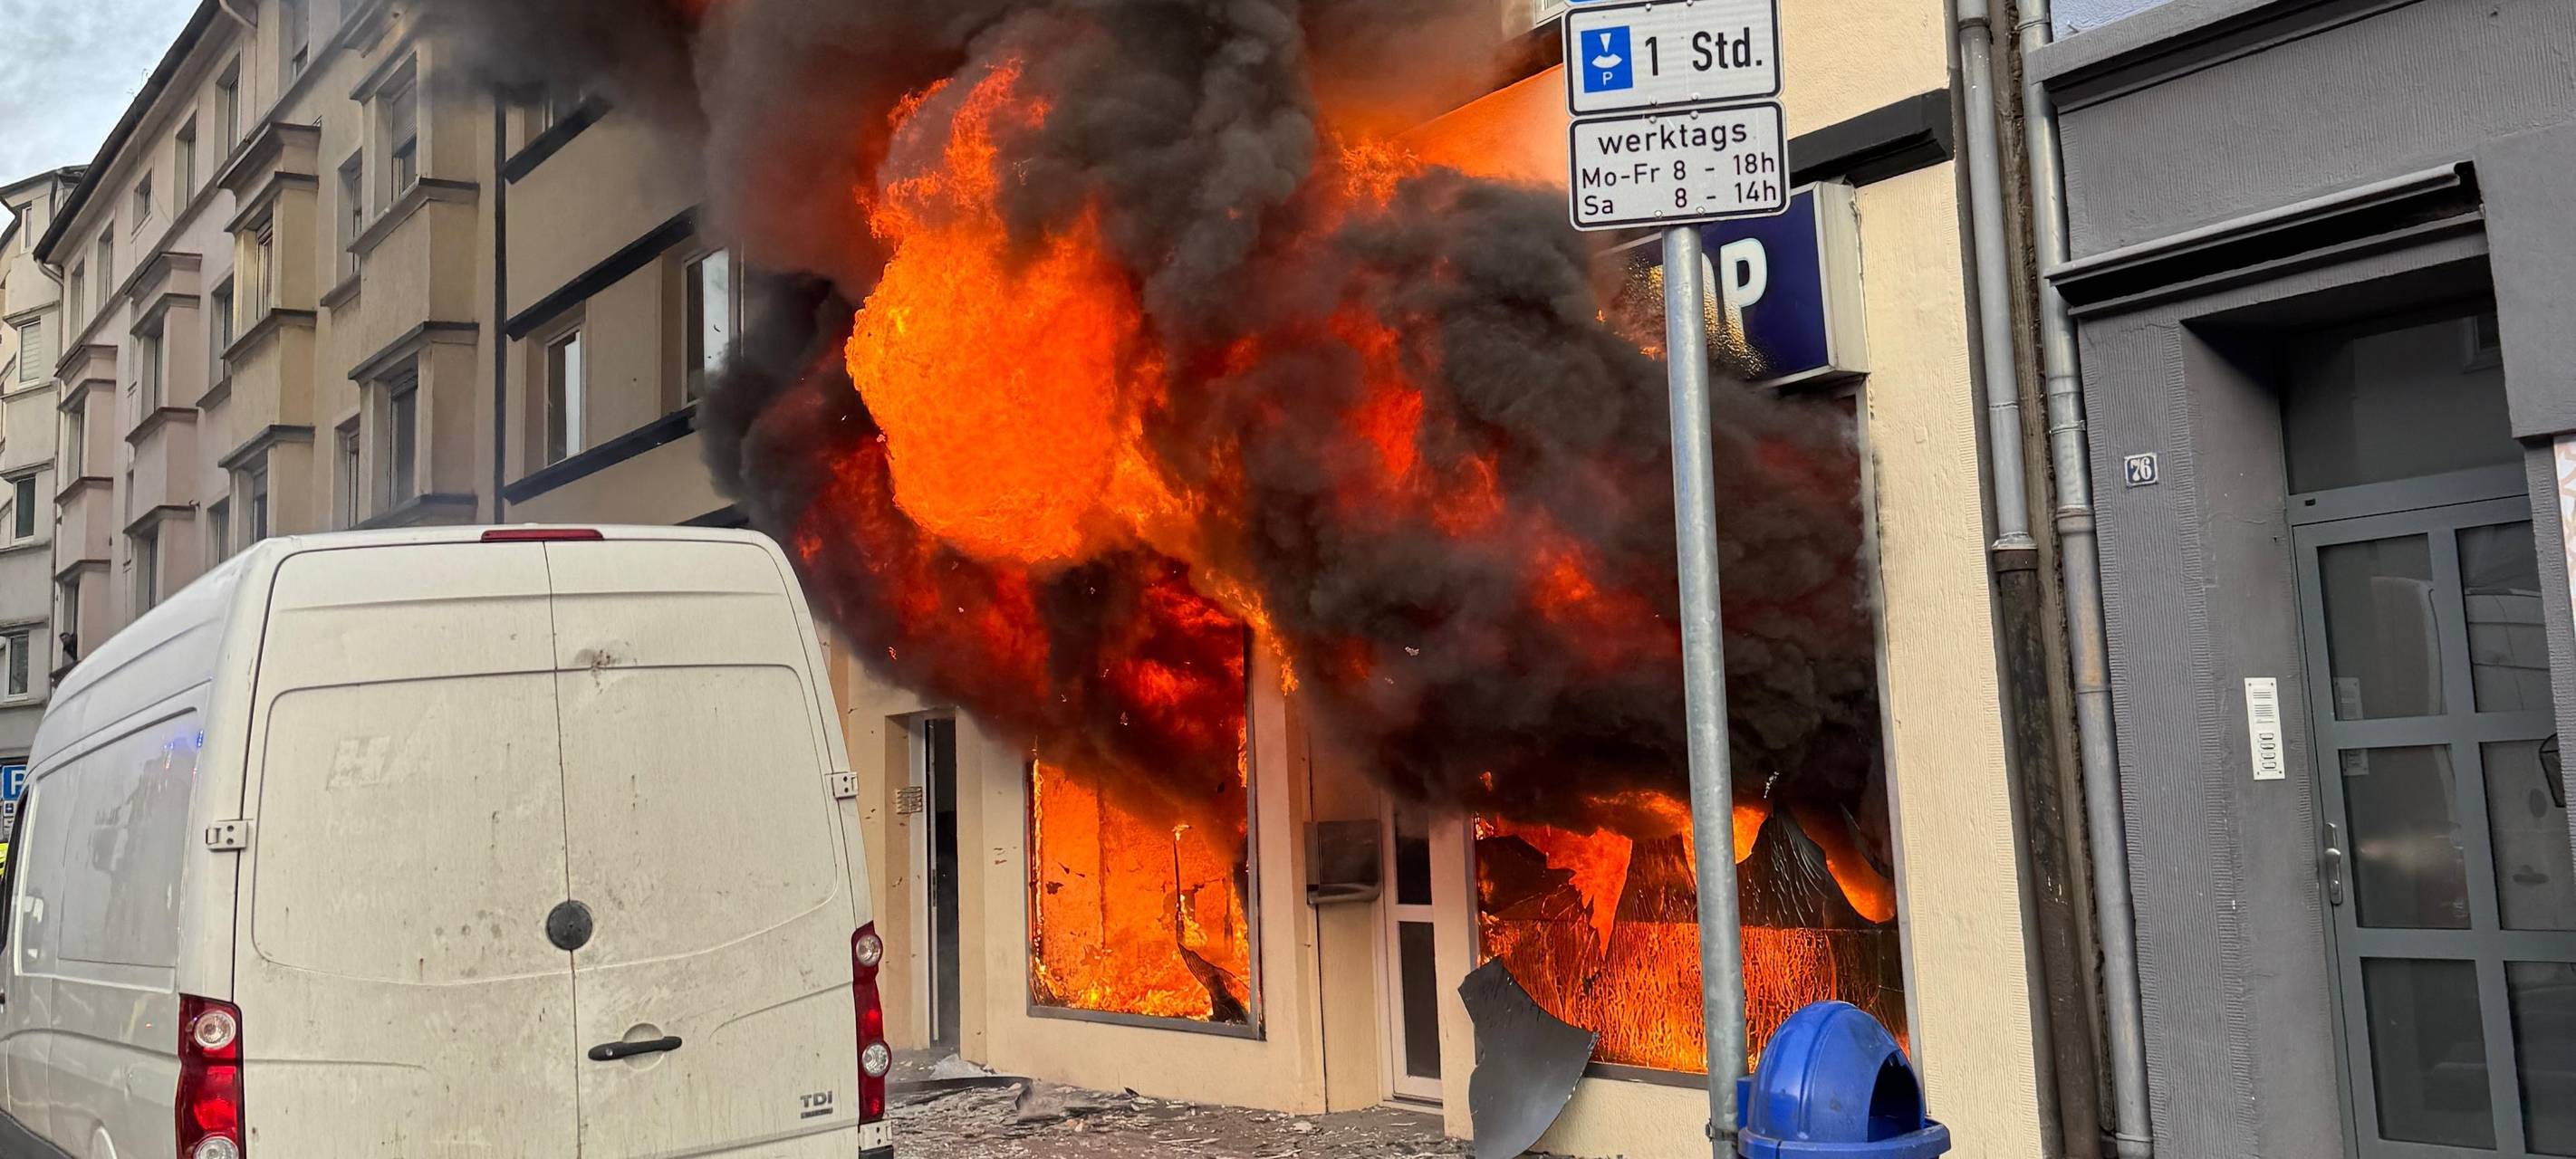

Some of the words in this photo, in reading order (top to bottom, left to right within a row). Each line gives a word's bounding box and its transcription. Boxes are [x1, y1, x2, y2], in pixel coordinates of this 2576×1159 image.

[1645, 36, 1658, 76] 1
[1692, 26, 1763, 72] Std.
[1602, 72, 1614, 86] P
[1598, 122, 1747, 155] werktags
[1581, 163, 1660, 189] Mo-Fr
[1673, 160, 1687, 181] 8
[1733, 151, 1775, 176] 18h
[1583, 195, 1614, 216] Sa
[1675, 187, 1687, 208] 8
[1734, 179, 1777, 204] 14h
[2130, 457, 2152, 481] 76
[800, 1090, 833, 1108] TDI
